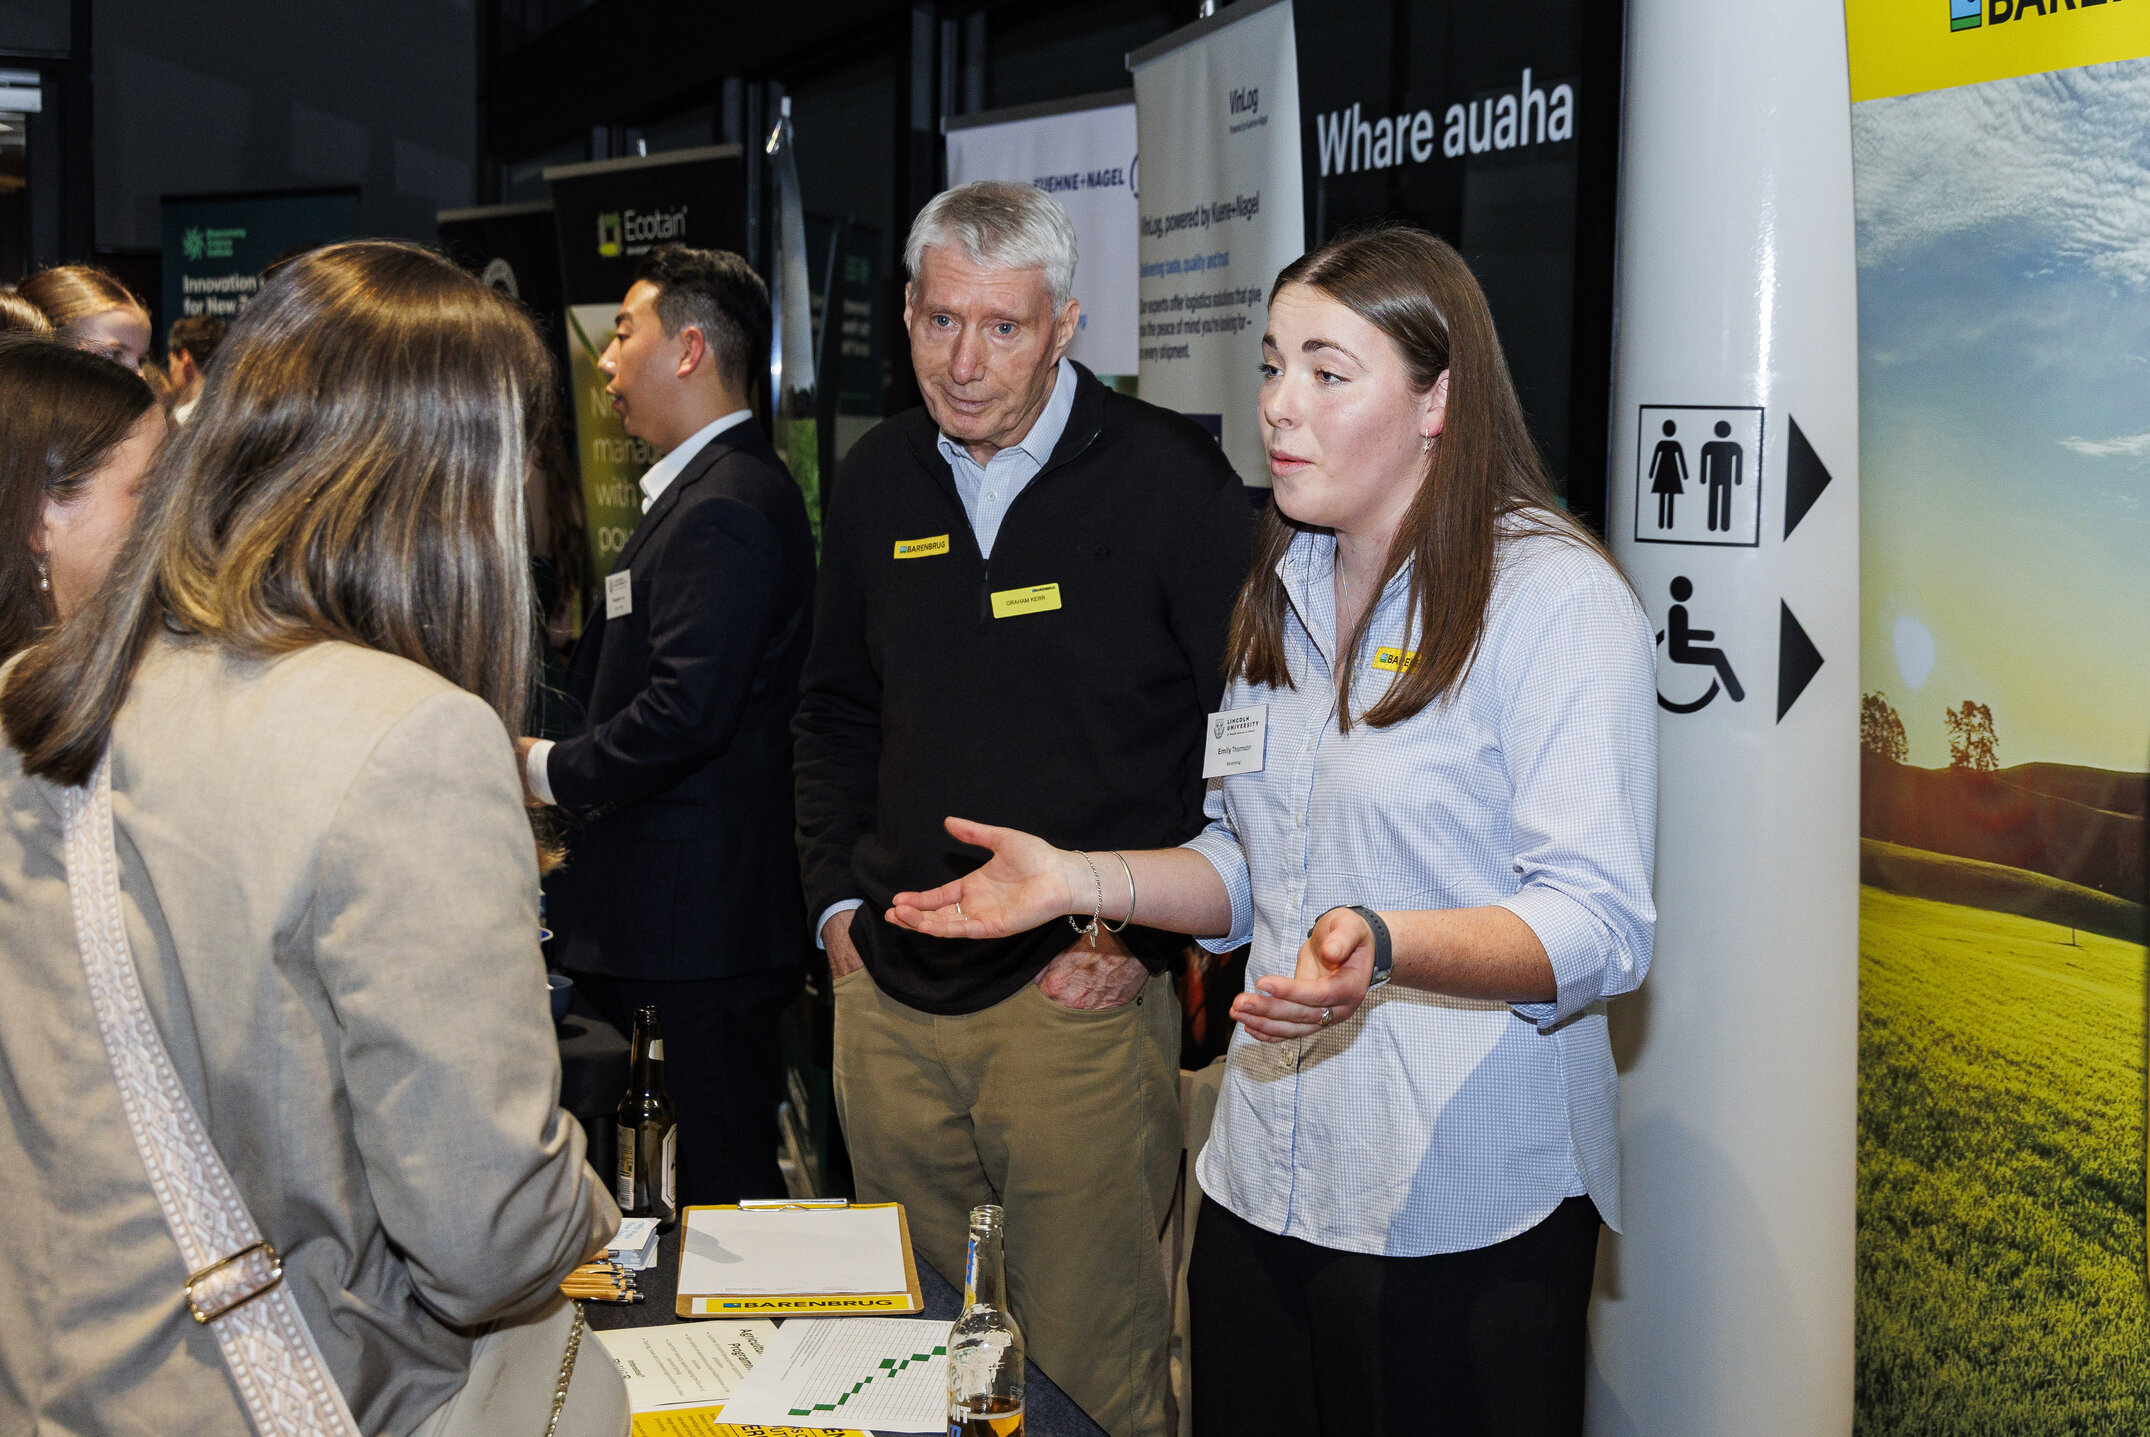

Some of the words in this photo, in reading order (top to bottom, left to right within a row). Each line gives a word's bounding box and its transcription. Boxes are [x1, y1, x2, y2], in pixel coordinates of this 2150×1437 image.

[1229, 87, 1259, 115] VinLog
[1317, 102, 1434, 177] Whare
[1443, 67, 1574, 159] auaha
[1200, 204, 1210, 230] by
[183, 272, 257, 294] Innovation
[907, 541, 945, 553] BARENBRUG
[1006, 597, 1029, 606] GRAHAM
[1030, 595, 1046, 603] KERR
[1227, 716, 1250, 725] LINCOLN
[1227, 721, 1259, 731] UNIVERSITY
[744, 1299, 893, 1309] BARENBRUG
